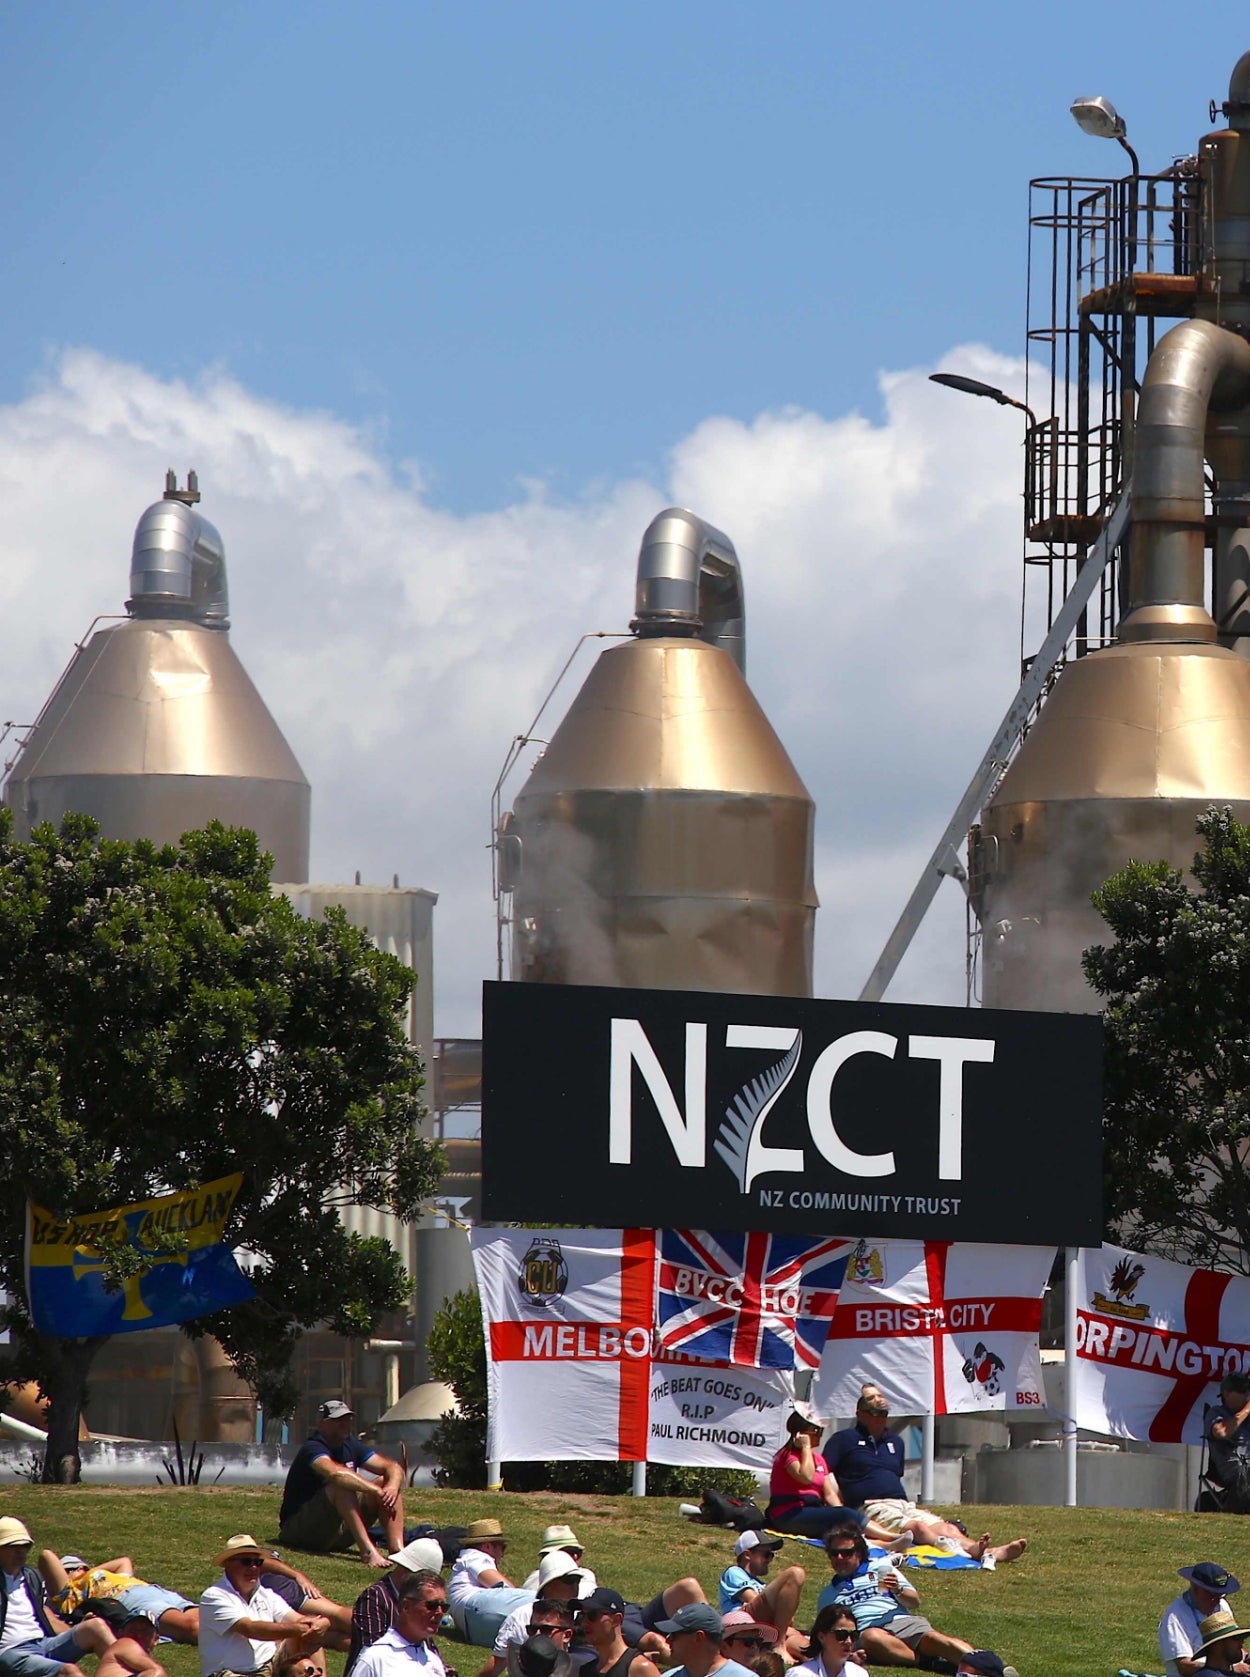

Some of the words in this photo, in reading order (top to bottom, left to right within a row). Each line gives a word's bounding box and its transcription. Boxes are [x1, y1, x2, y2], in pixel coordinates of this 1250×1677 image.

[608, 1017, 996, 1194] NZCT
[759, 1189, 784, 1208] NZ
[789, 1191, 902, 1213] COMMUNITY
[905, 1196, 962, 1216] TRUST
[526, 1259, 560, 1295] CU
[674, 1268, 746, 1307] BVCC
[949, 1303, 996, 1328] CITY
[671, 1377, 702, 1394] BEAT
[704, 1379, 743, 1401] GOES
[1016, 1391, 1041, 1405] BS3
[681, 1403, 715, 1419] R.I.P
[651, 1422, 674, 1440] PAUL
[676, 1426, 766, 1447] RICHMOND
